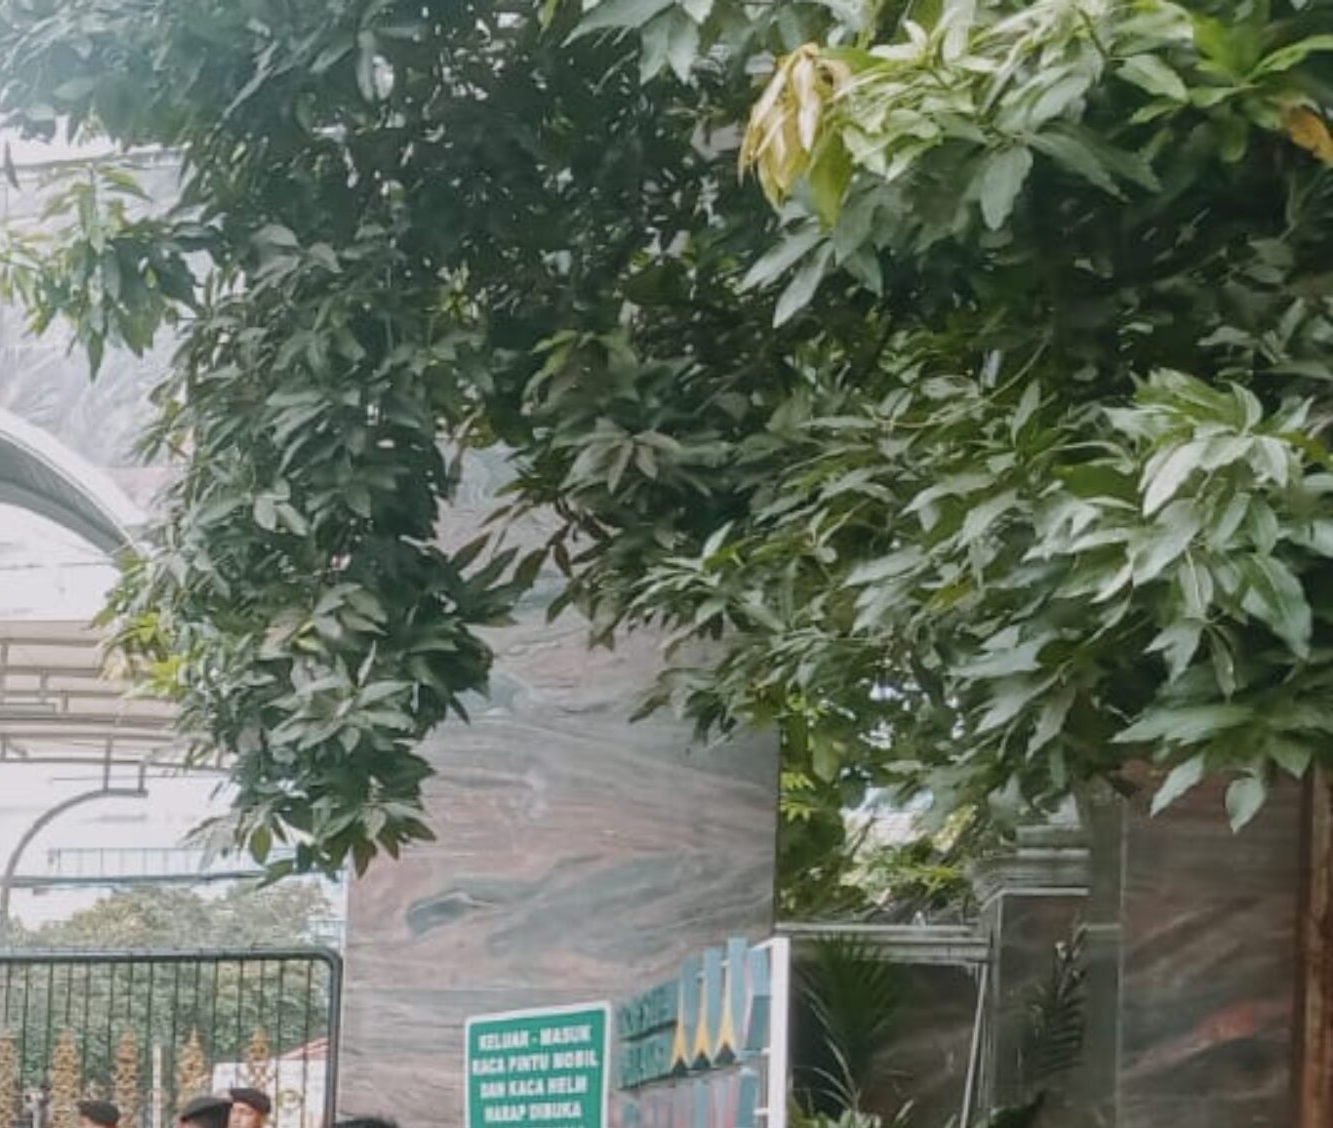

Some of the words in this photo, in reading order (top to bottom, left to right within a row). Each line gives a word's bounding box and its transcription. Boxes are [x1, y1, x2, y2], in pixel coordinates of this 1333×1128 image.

[478, 1030, 529, 1050] KELUAR
[539, 1025, 592, 1046] MASUK
[472, 1057, 505, 1076] KACA
[508, 1053, 550, 1072] PINTU
[553, 1049, 598, 1069] MOBIL
[480, 1081, 506, 1099] DAN
[508, 1079, 544, 1097] KACA
[547, 1076, 587, 1094] HELM
[484, 1104, 527, 1122] HARAP
[530, 1101, 582, 1120] DIBUKA
